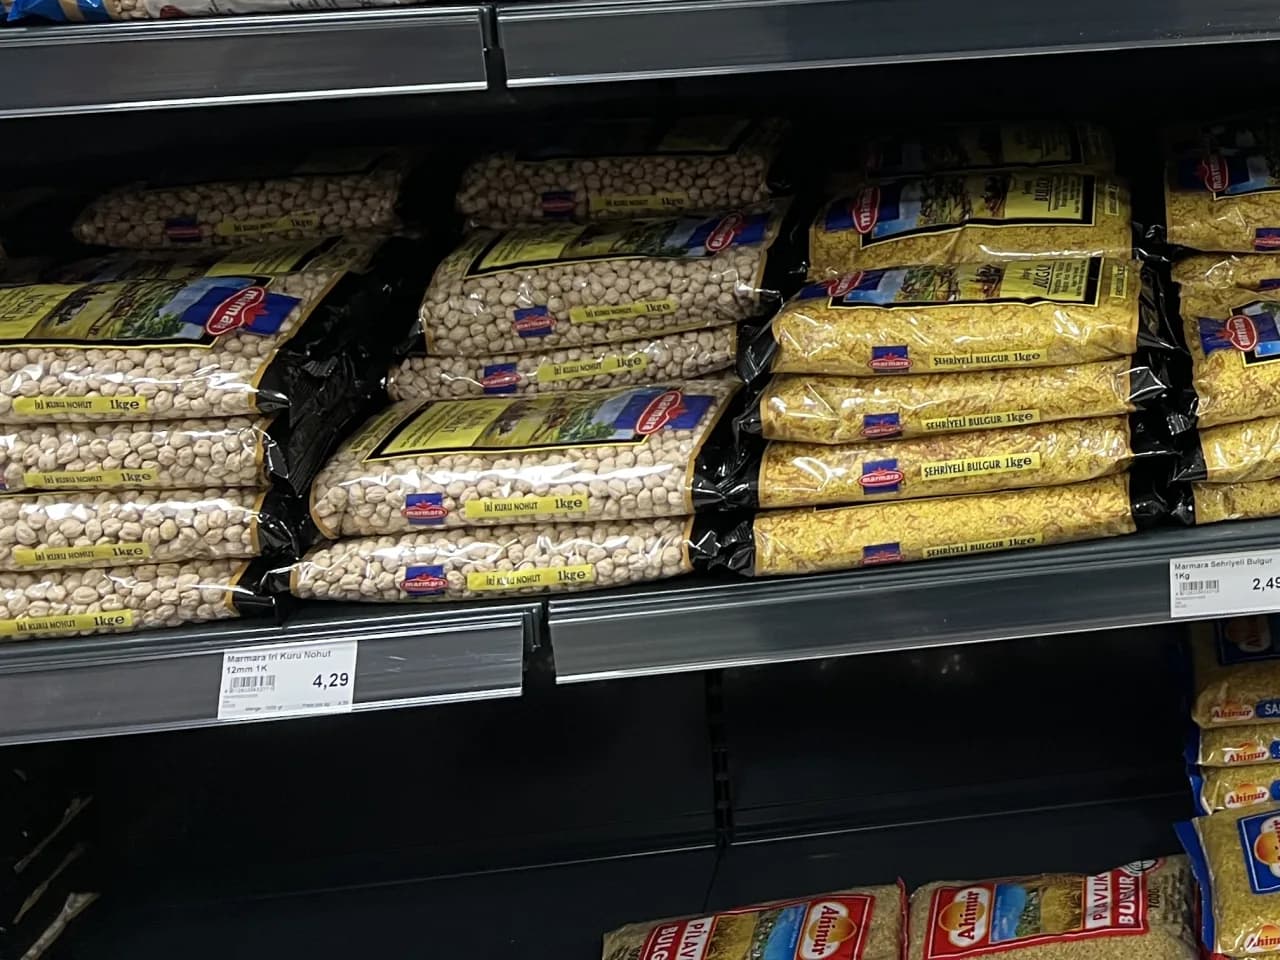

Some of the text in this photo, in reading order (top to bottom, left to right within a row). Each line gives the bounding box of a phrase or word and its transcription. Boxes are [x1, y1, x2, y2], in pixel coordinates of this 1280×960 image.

[976, 355, 1009, 363] BULGUR
[967, 461, 1000, 471] BULGUR
[514, 502, 538, 510] NOHUT
[304, 650, 331, 658] Nohut
[227, 666, 252, 674] 12mm
[313, 673, 349, 690] 4,29
